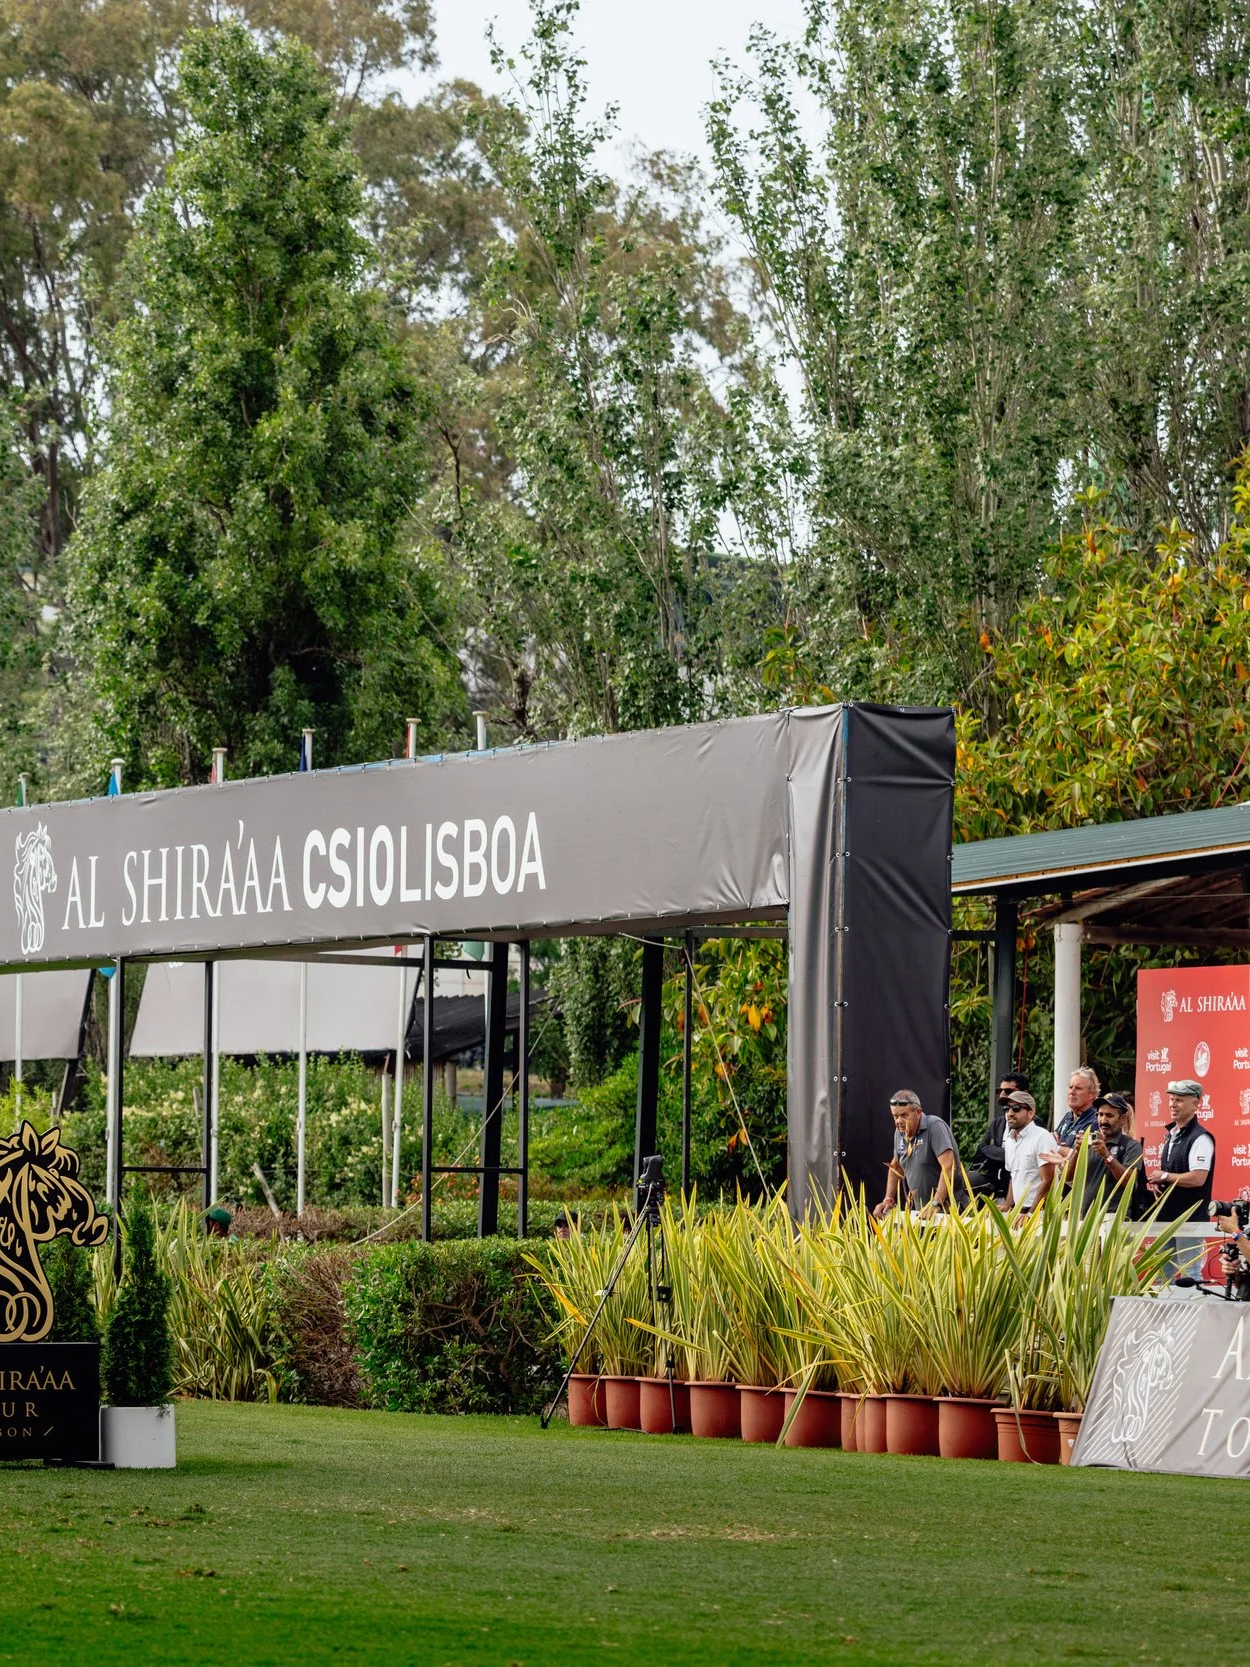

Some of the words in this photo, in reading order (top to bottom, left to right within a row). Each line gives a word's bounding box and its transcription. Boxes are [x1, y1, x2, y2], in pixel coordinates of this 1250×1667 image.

[61, 855, 105, 930] AL
[302, 811, 547, 910] CSIOLISBOA
[1179, 996, 1193, 1012] AL
[1147, 1049, 1160, 1060] visit
[1234, 1047, 1248, 1058] visit
[1145, 1061, 1172, 1075] Portugal
[1233, 1059, 1250, 1070] Portu
[1233, 1144, 1247, 1155] visit
[1143, 1157, 1161, 1167] Portu
[1231, 1156, 1250, 1167] Portu
[1211, 1315, 1250, 1380] A
[1196, 1407, 1250, 1459] TO
